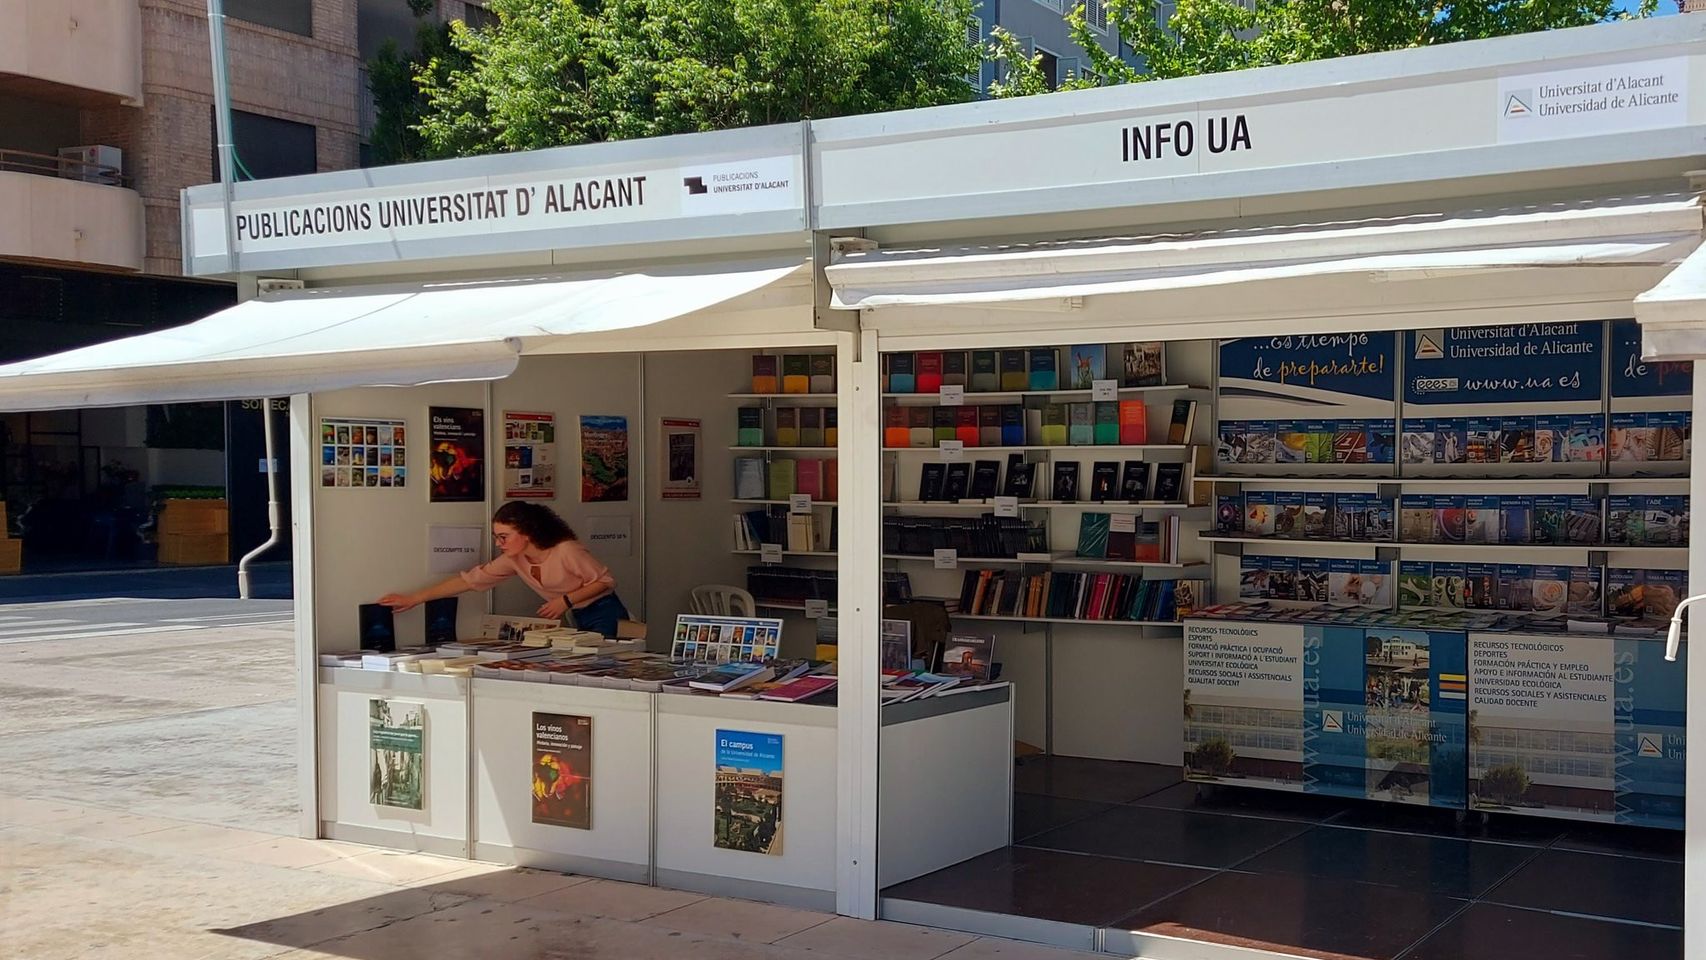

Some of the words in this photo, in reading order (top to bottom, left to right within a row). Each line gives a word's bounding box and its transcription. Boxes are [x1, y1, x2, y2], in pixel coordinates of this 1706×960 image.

[1539, 81, 1601, 99] Universitat
[1605, 75, 1664, 92] d'Alacant
[1538, 98, 1607, 117] Universidad
[1611, 96, 1625, 109] de
[1627, 91, 1679, 108] Alicante
[1122, 120, 1194, 162] INFO
[1207, 114, 1252, 154] UA
[712, 171, 759, 182] PUBLICACIONS
[713, 183, 753, 193] UNIVERSITAT
[754, 180, 789, 190] D'ALACANT
[236, 202, 372, 240] PUBLICACIONS
[378, 189, 508, 229] UNIVERSITAT
[544, 176, 647, 214] ALACANT
[1450, 325, 1515, 341] Universitat
[1518, 322, 1579, 338] d'Alacant
[1450, 343, 1515, 359] Universidad
[1523, 343, 1537, 356] de
[1539, 340, 1593, 355] Alicante
[1253, 356, 1273, 380] de
[1277, 354, 1385, 385] prepararte!
[1624, 353, 1649, 379] de
[1188, 626, 1218, 635] RECURSOS
[1188, 634, 1213, 642] ESPORTS
[1188, 642, 1219, 651] FORMACIÓ
[1252, 646, 1283, 655] OCUPACIÓ
[1473, 641, 1509, 650] RECURSOS
[1511, 642, 1565, 653] TECNOLÓGICOS
[1215, 652, 1251, 661] INFORMACIÓ
[1473, 650, 1508, 658] DEPORTES
[1188, 660, 1225, 668] UNIVERSITAT
[1473, 658, 1515, 668] FORMACIÓN
[1517, 659, 1551, 670] PRÁCTICA
[1552, 663, 1558, 671] Y
[1560, 663, 1589, 672] EMPLEO
[1188, 668, 1218, 677] RECURSOS
[1219, 670, 1243, 679] SOCIALS
[1247, 672, 1292, 682] ASSISTENCIALS
[1474, 668, 1498, 677] APOYO
[1506, 669, 1556, 680] INFORMACIÓN
[1558, 672, 1568, 680] AL
[1569, 672, 1614, 683] ESTUDIANTE
[1188, 677, 1215, 685] QUALITAT
[1217, 679, 1240, 687] DOCENT
[1474, 678, 1520, 687] UNIVERSIDAD
[1522, 679, 1562, 689] ECOLÓGICA
[1474, 687, 1510, 697] RECURSOS
[1511, 690, 1545, 699] SOCIALES
[1546, 691, 1552, 699] Y
[1553, 692, 1607, 702] ASISTENCIALES
[1474, 696, 1505, 705] CALIDAD
[1506, 698, 1538, 708] DOCENTE
[536, 723, 546, 731] Los
[547, 724, 562, 733] vinos
[536, 732, 569, 741] valencianos
[720, 739, 728, 747] El
[729, 741, 754, 751] campus
